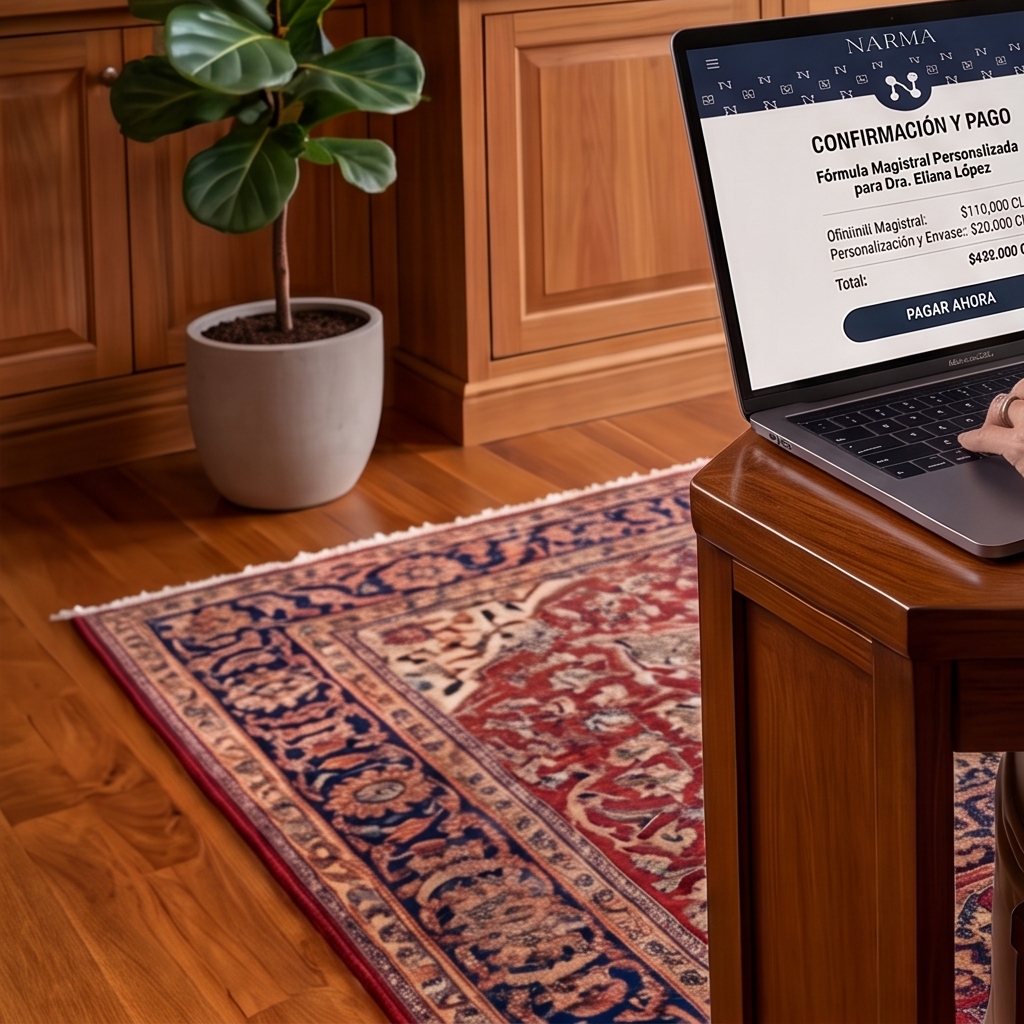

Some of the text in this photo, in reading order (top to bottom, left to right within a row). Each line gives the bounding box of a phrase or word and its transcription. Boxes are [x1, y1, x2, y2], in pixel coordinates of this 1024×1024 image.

[845, 29, 938, 55] NARMA
[811, 107, 1012, 154] CONFIRMACIÓN Y PAGO
[816, 163, 869, 184] Fórmula
[871, 153, 931, 176] Magistral
[854, 162, 992, 198] para Dra. Eliana López
[874, 214, 929, 235] Magistral:
[960, 198, 1010, 219] $110,000
[830, 235, 916, 261] Personalización
[916, 234, 924, 249] y
[970, 215, 1013, 236] $20.000
[835, 273, 868, 291] Total:
[906, 291, 997, 321] PAGAR AHORA
